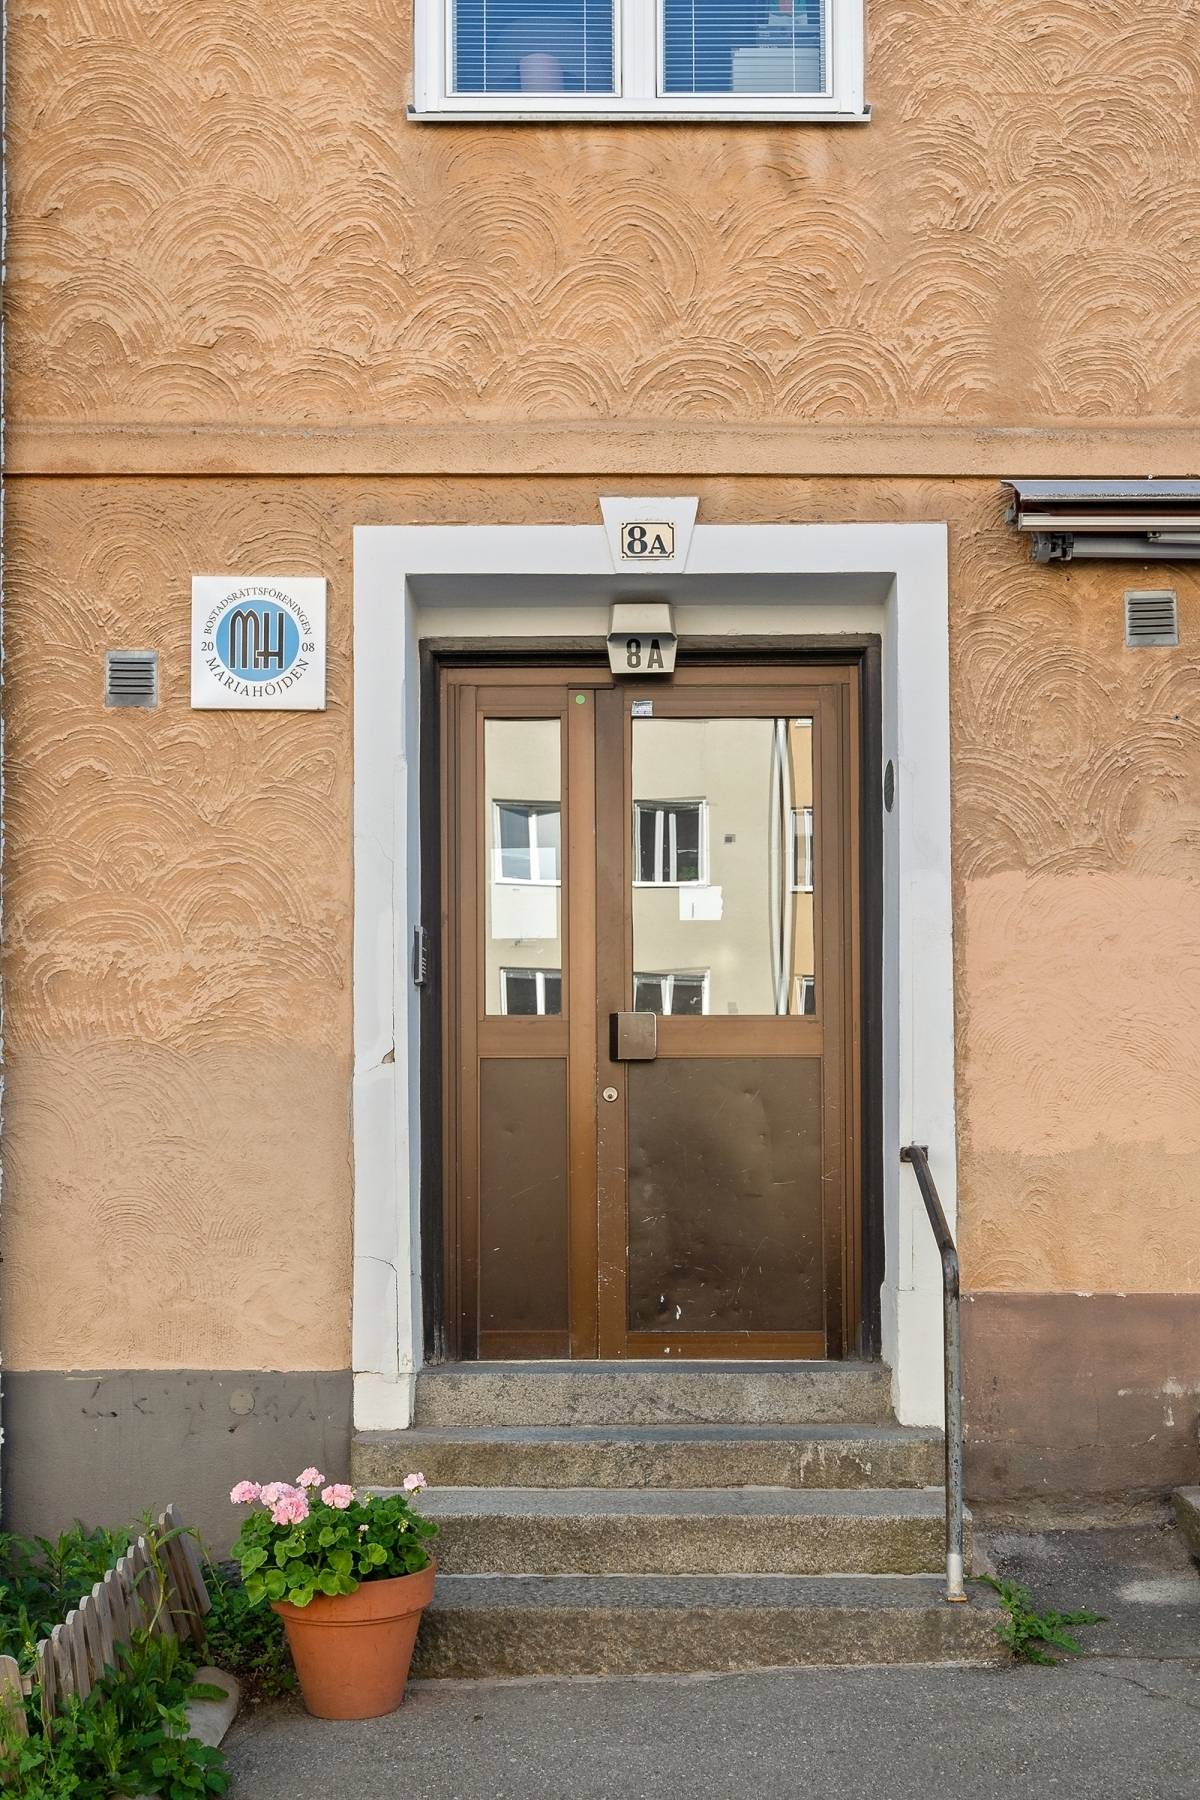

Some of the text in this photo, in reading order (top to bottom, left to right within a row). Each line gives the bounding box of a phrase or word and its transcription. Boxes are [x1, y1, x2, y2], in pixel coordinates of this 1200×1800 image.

[627, 526, 668, 555] 8A
[203, 587, 312, 635] BOSTADSRÄTTSFÖRENINGEN
[201, 641, 315, 652] 20 08
[206, 657, 309, 697] MARIAHÖJDEN
